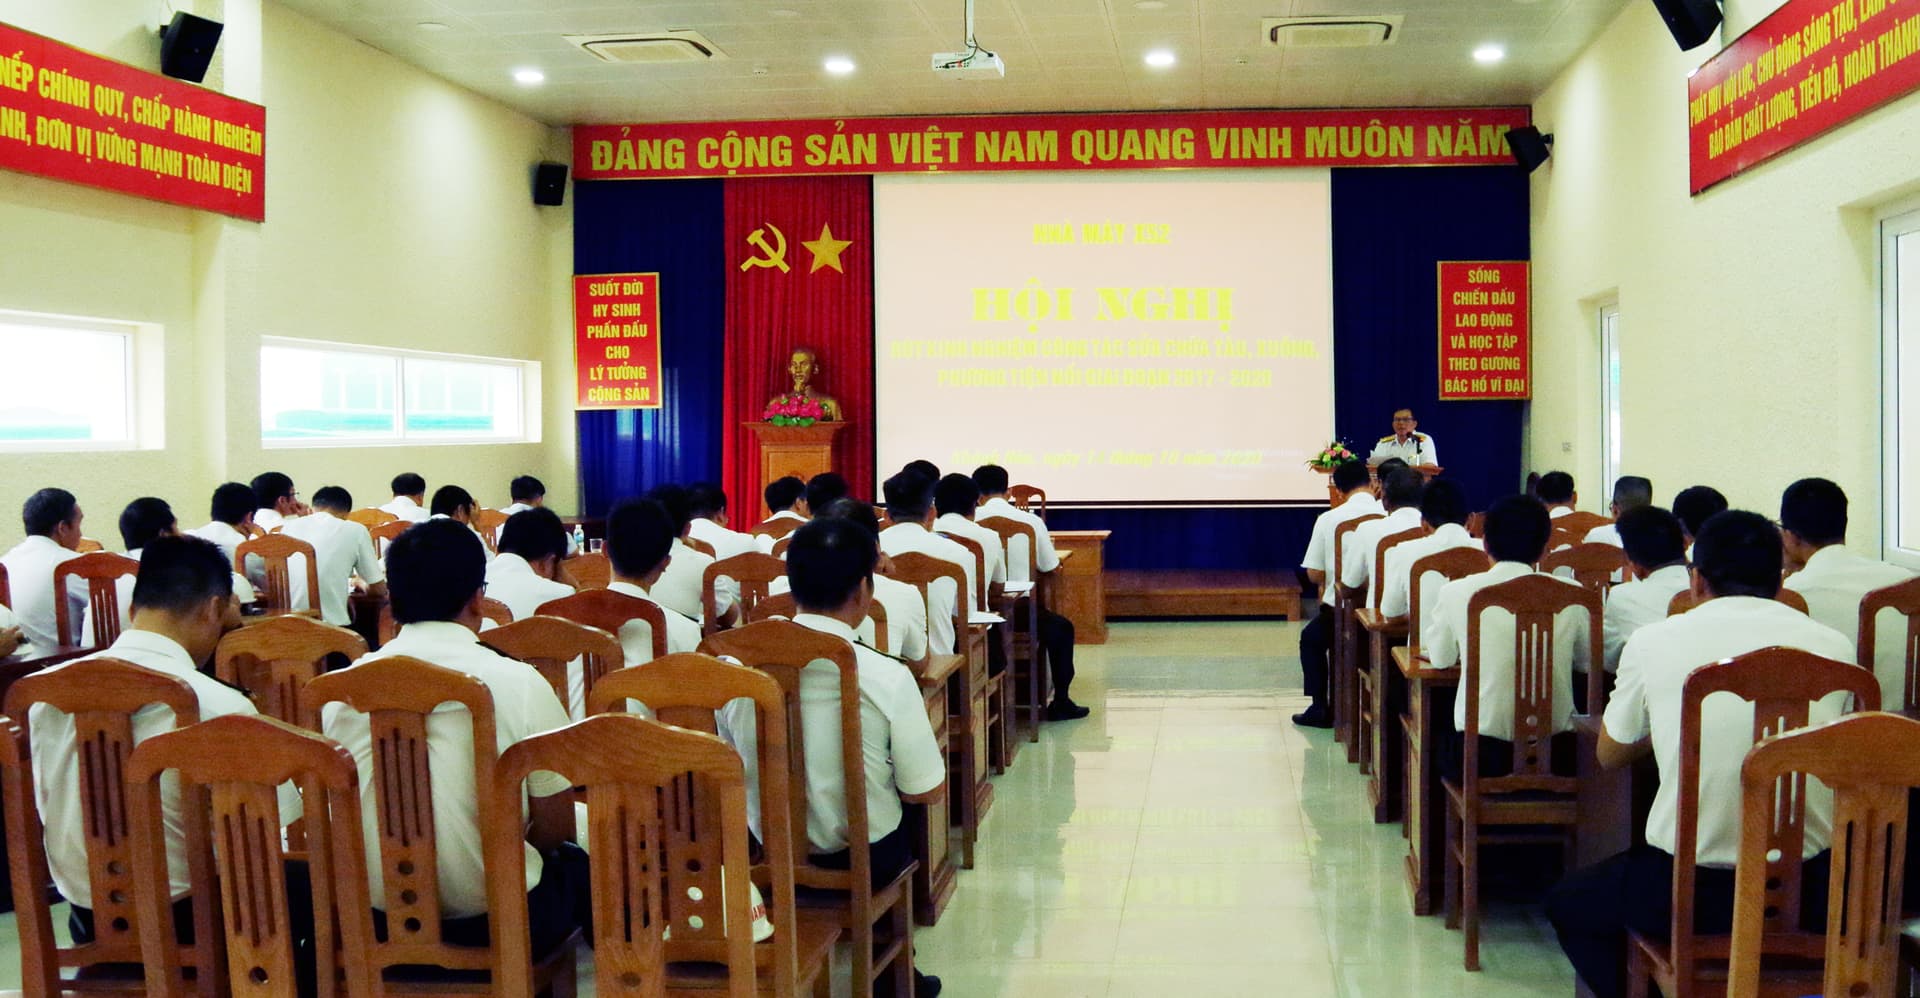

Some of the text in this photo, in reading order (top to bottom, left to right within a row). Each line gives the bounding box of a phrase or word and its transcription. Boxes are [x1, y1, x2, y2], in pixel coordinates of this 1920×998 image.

[1757, 37, 1774, 86] CHỦ
[1776, 32, 1801, 77] ĐỘNG
[1803, 13, 1831, 57] SÁNG
[1832, 0, 1858, 43] TẠO,
[1709, 119, 1723, 160] BẢO
[1744, 96, 1764, 141] CHẤT
[1766, 87, 1797, 131] LƯỢNG,
[1800, 63, 1821, 112] TIẾN
[1844, 39, 1876, 89] HOÀN
[1878, 13, 1920, 70] THÀNH
[0, 50, 262, 156] NẾP CHÍNH QUY, CHẤP HÀNH NGHIÊM
[36, 115, 72, 152] ĐƠN
[76, 126, 92, 162] VỊ
[96, 127, 137, 167] VỮNG
[140, 142, 183, 179] MẠNH
[186, 153, 221, 187] TOÀN
[223, 161, 252, 197] DIỆN
[591, 118, 1511, 175] ĐẢNG CỘNG SẢN VIỆT NAM QUANG VINH MUÔN NĂM
[1032, 217, 1076, 245] NHÀ
[1081, 217, 1127, 245] MÁY
[1468, 265, 1500, 283] SỐNG
[589, 278, 643, 296] SUỐT ĐỜI
[1453, 287, 1515, 305] CHIẾN ĐẤU
[593, 303, 641, 317] HY SINH
[971, 276, 1237, 334] HỘI NGHỊ
[587, 319, 647, 338] PHẤN ĐẤU
[1455, 311, 1513, 330] LAO ĐỘNG
[606, 345, 630, 359] CHO
[1451, 332, 1518, 352] VÀ HỌC TẬP
[590, 361, 647, 381] LÝ TƯỞNG
[1449, 357, 1521, 371] THEO GƯƠNG
[588, 382, 650, 404] CỘNG SẢN
[1445, 375, 1524, 395] BÁC HỒ VĨ ĐẠI
